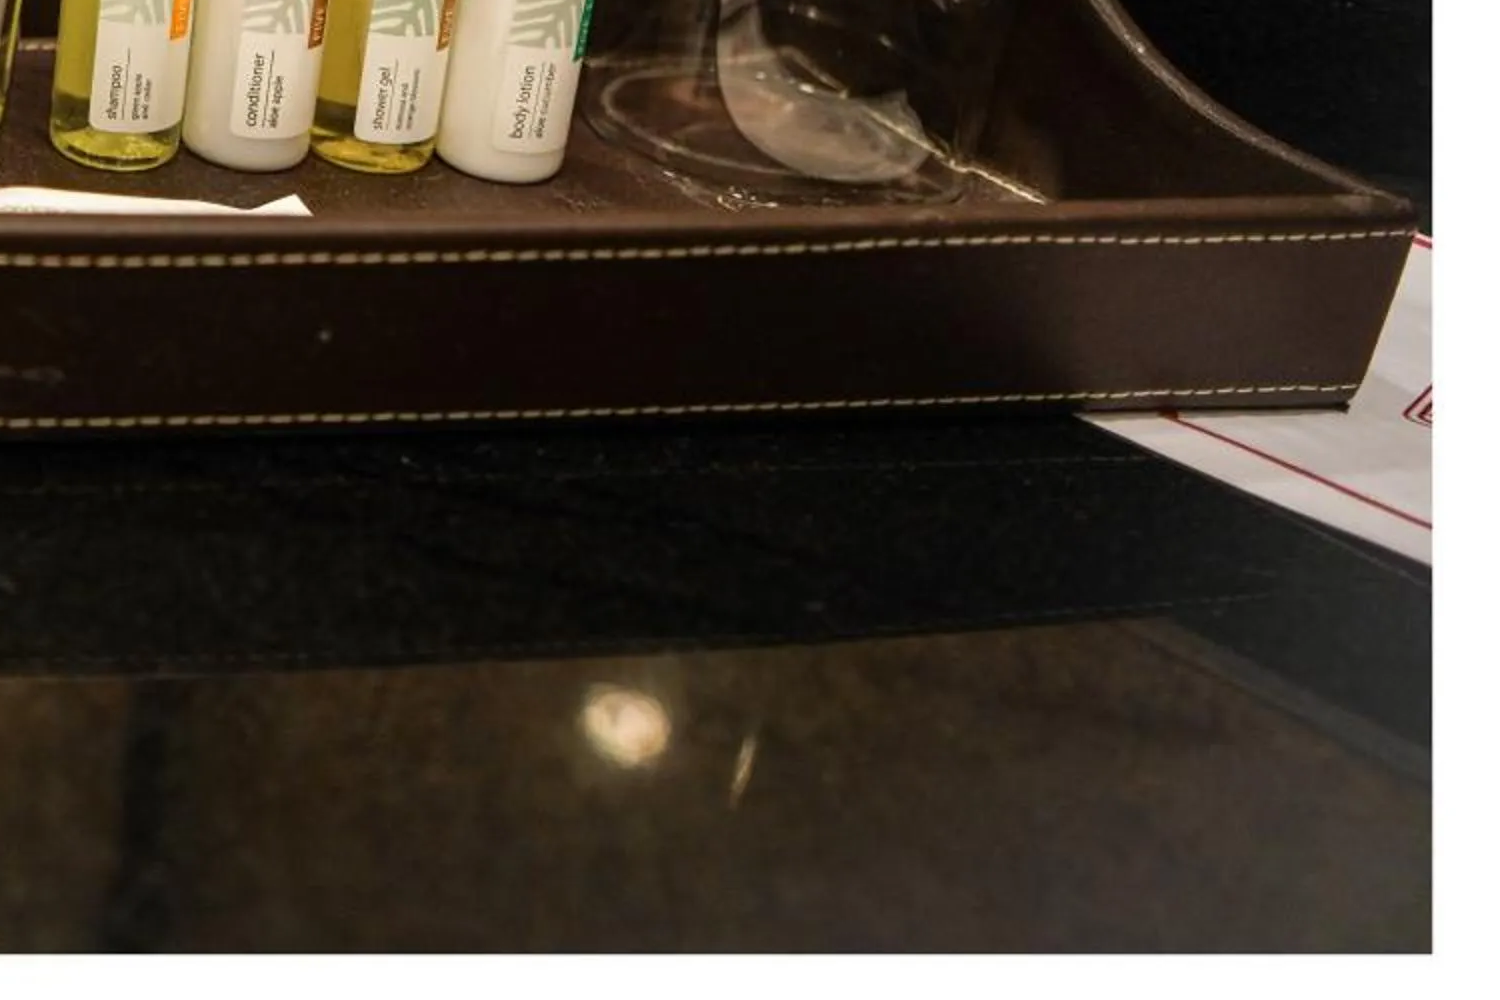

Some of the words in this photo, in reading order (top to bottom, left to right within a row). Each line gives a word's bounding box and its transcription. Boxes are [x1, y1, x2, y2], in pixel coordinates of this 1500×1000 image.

[106, 65, 122, 120] shampoo
[245, 52, 265, 127] conditioner
[378, 67, 393, 87] gel
[515, 66, 536, 104] lotion
[372, 88, 389, 131] shower
[508, 108, 531, 138] body
